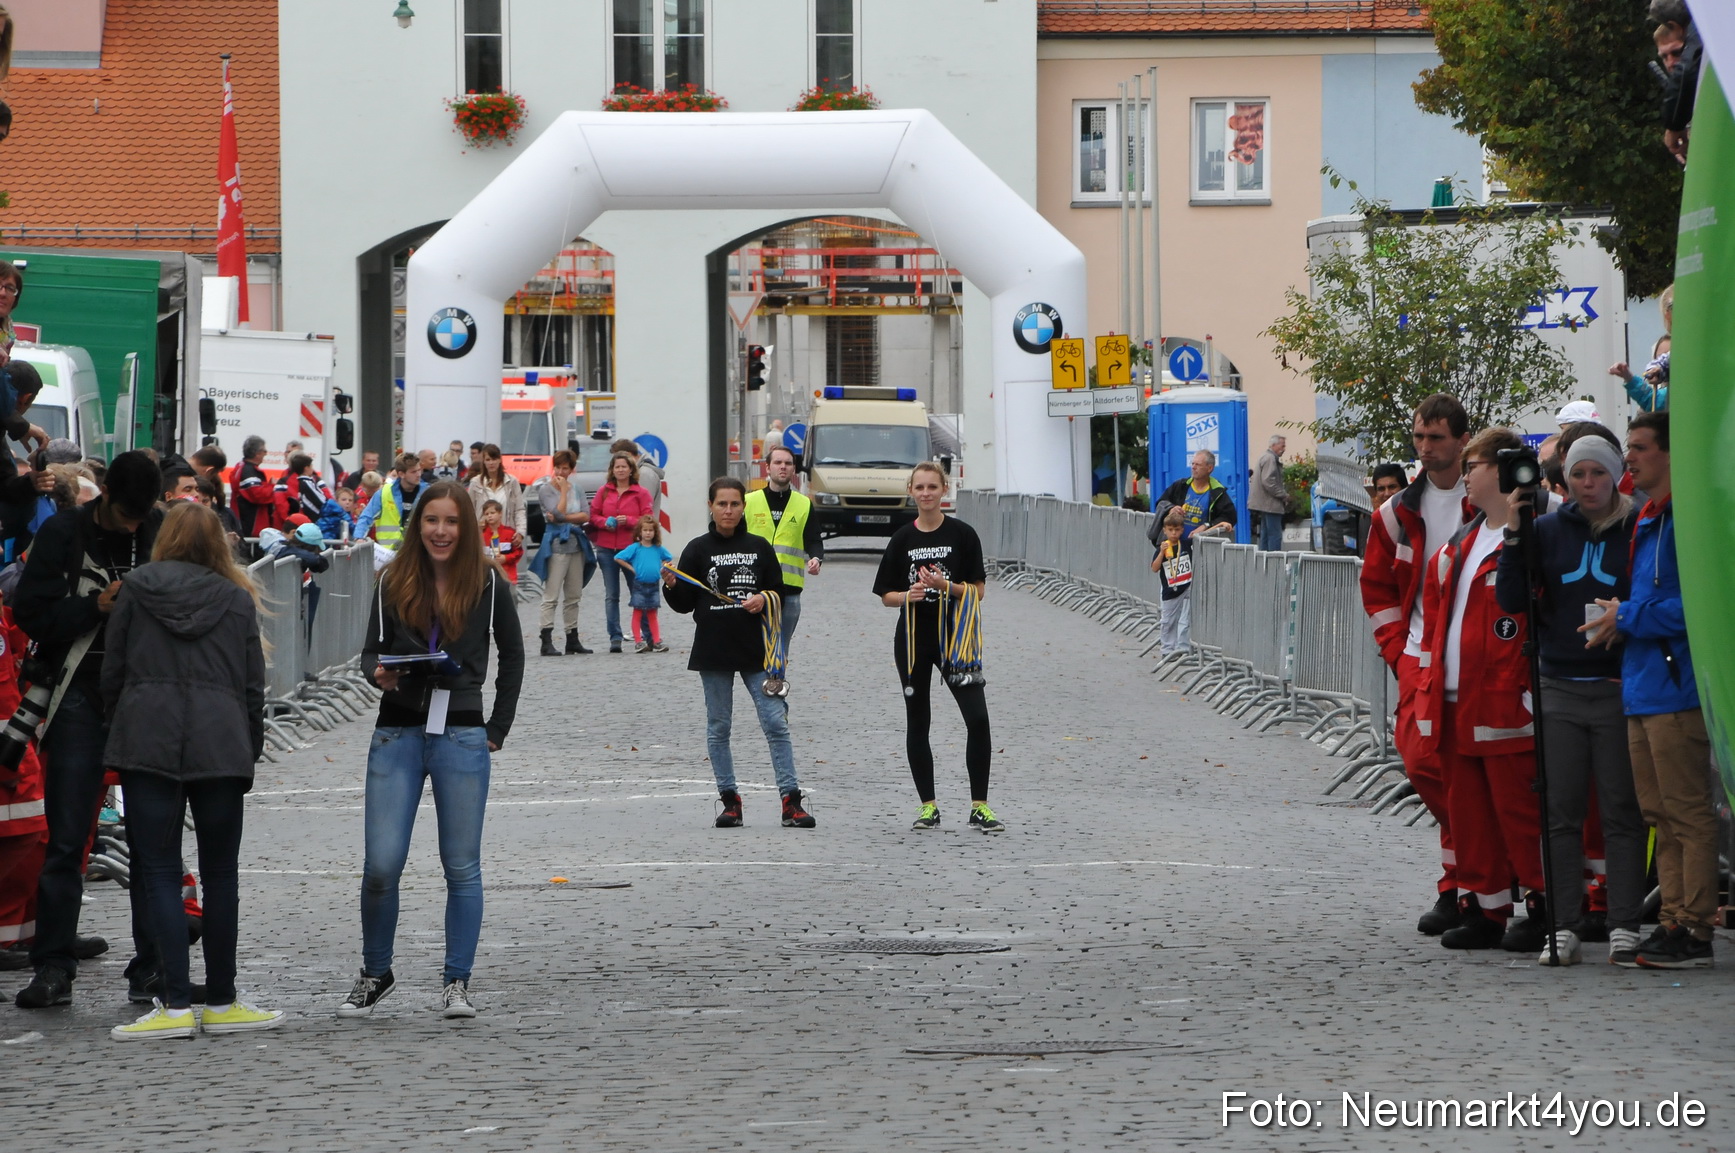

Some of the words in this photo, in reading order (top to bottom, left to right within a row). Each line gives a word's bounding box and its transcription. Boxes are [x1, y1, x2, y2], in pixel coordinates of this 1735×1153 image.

[208, 387, 279, 400] Bayerisches
[1049, 400, 1082, 408] Nürnberger
[1094, 396, 1124, 404] Altdorfer
[216, 403, 242, 412] otes
[216, 418, 241, 427] reuz
[907, 546, 953, 557] NEUMARKTER
[710, 552, 758, 562] NEUMARKTER
[911, 552, 949, 562] STADTLAUF
[715, 558, 755, 567] STADTLAUF
